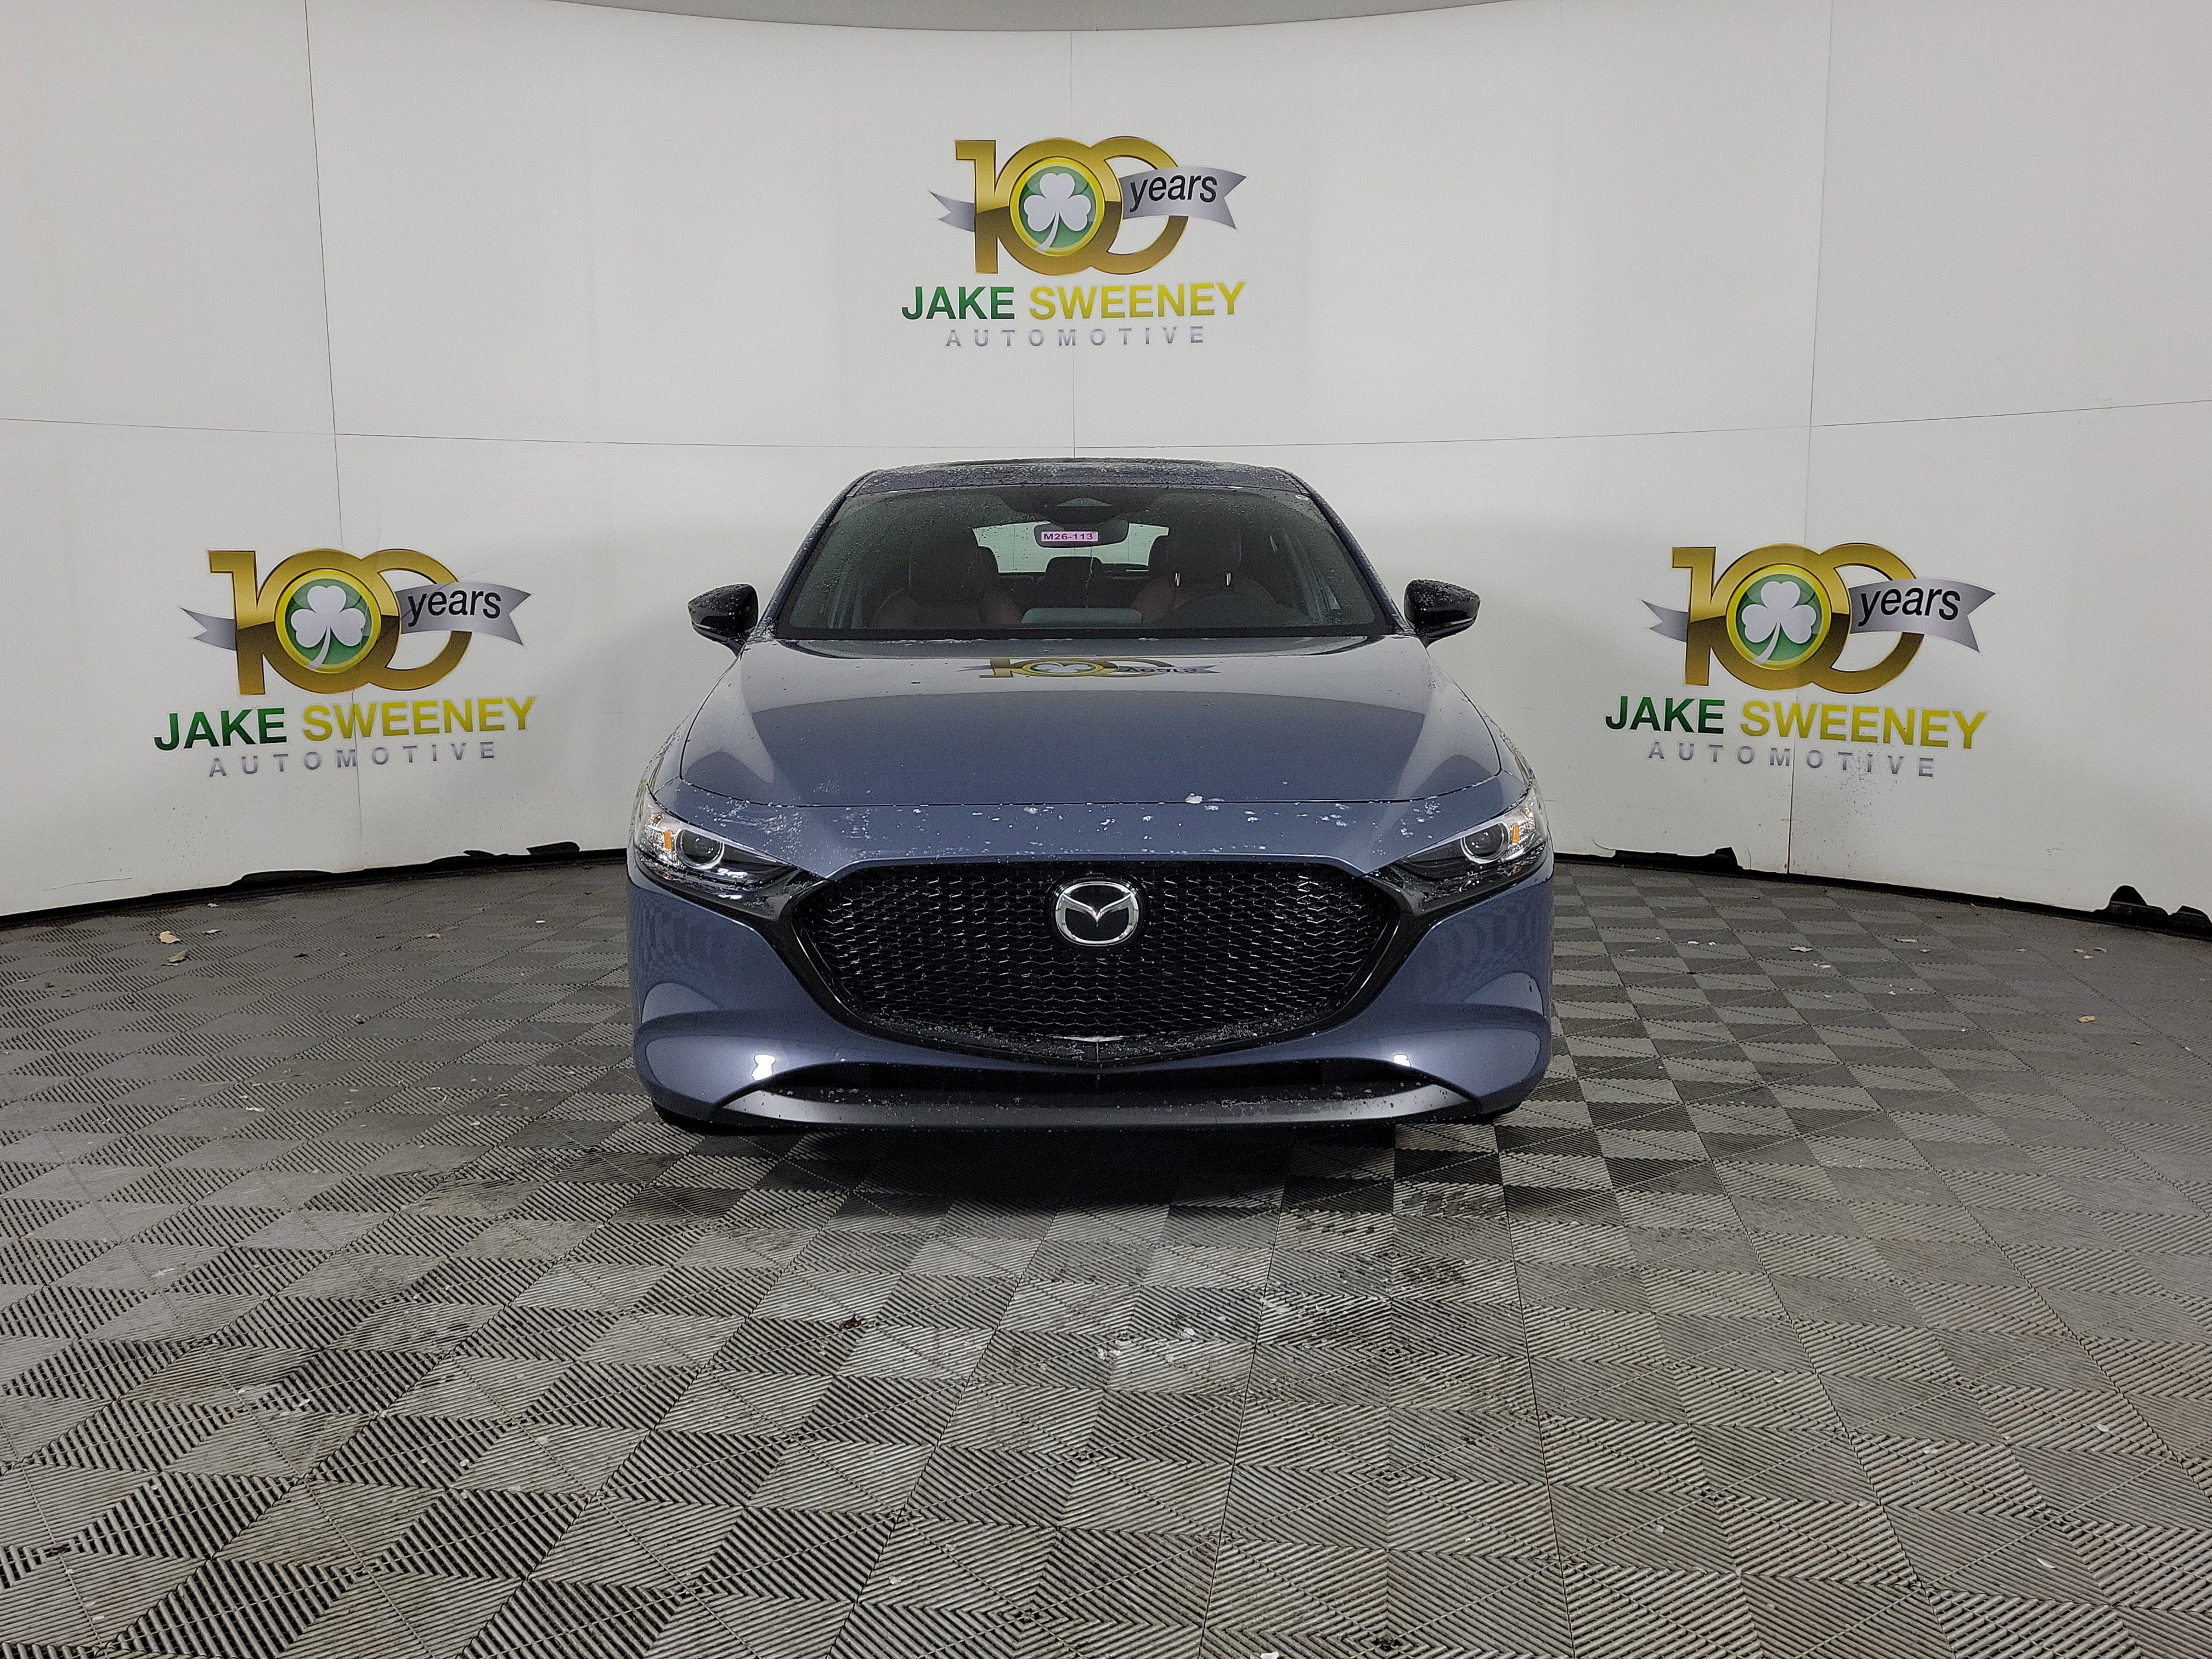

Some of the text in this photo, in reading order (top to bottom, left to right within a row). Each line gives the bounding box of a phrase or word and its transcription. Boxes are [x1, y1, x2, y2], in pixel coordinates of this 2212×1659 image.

[955, 136, 1217, 275] 100 years
[901, 281, 1245, 320] JAKE SWEENEY
[945, 325, 1204, 347] AUTOMOTIVE
[208, 548, 501, 696] 100 years
[1671, 542, 1961, 693] 100 years
[154, 696, 536, 752] JAKE SWEENEY
[1605, 696, 1988, 749] JAKE SWEENEY
[208, 742, 495, 777] AUTOMOTIVE
[1647, 741, 1934, 778] AUTOMOTIVE
